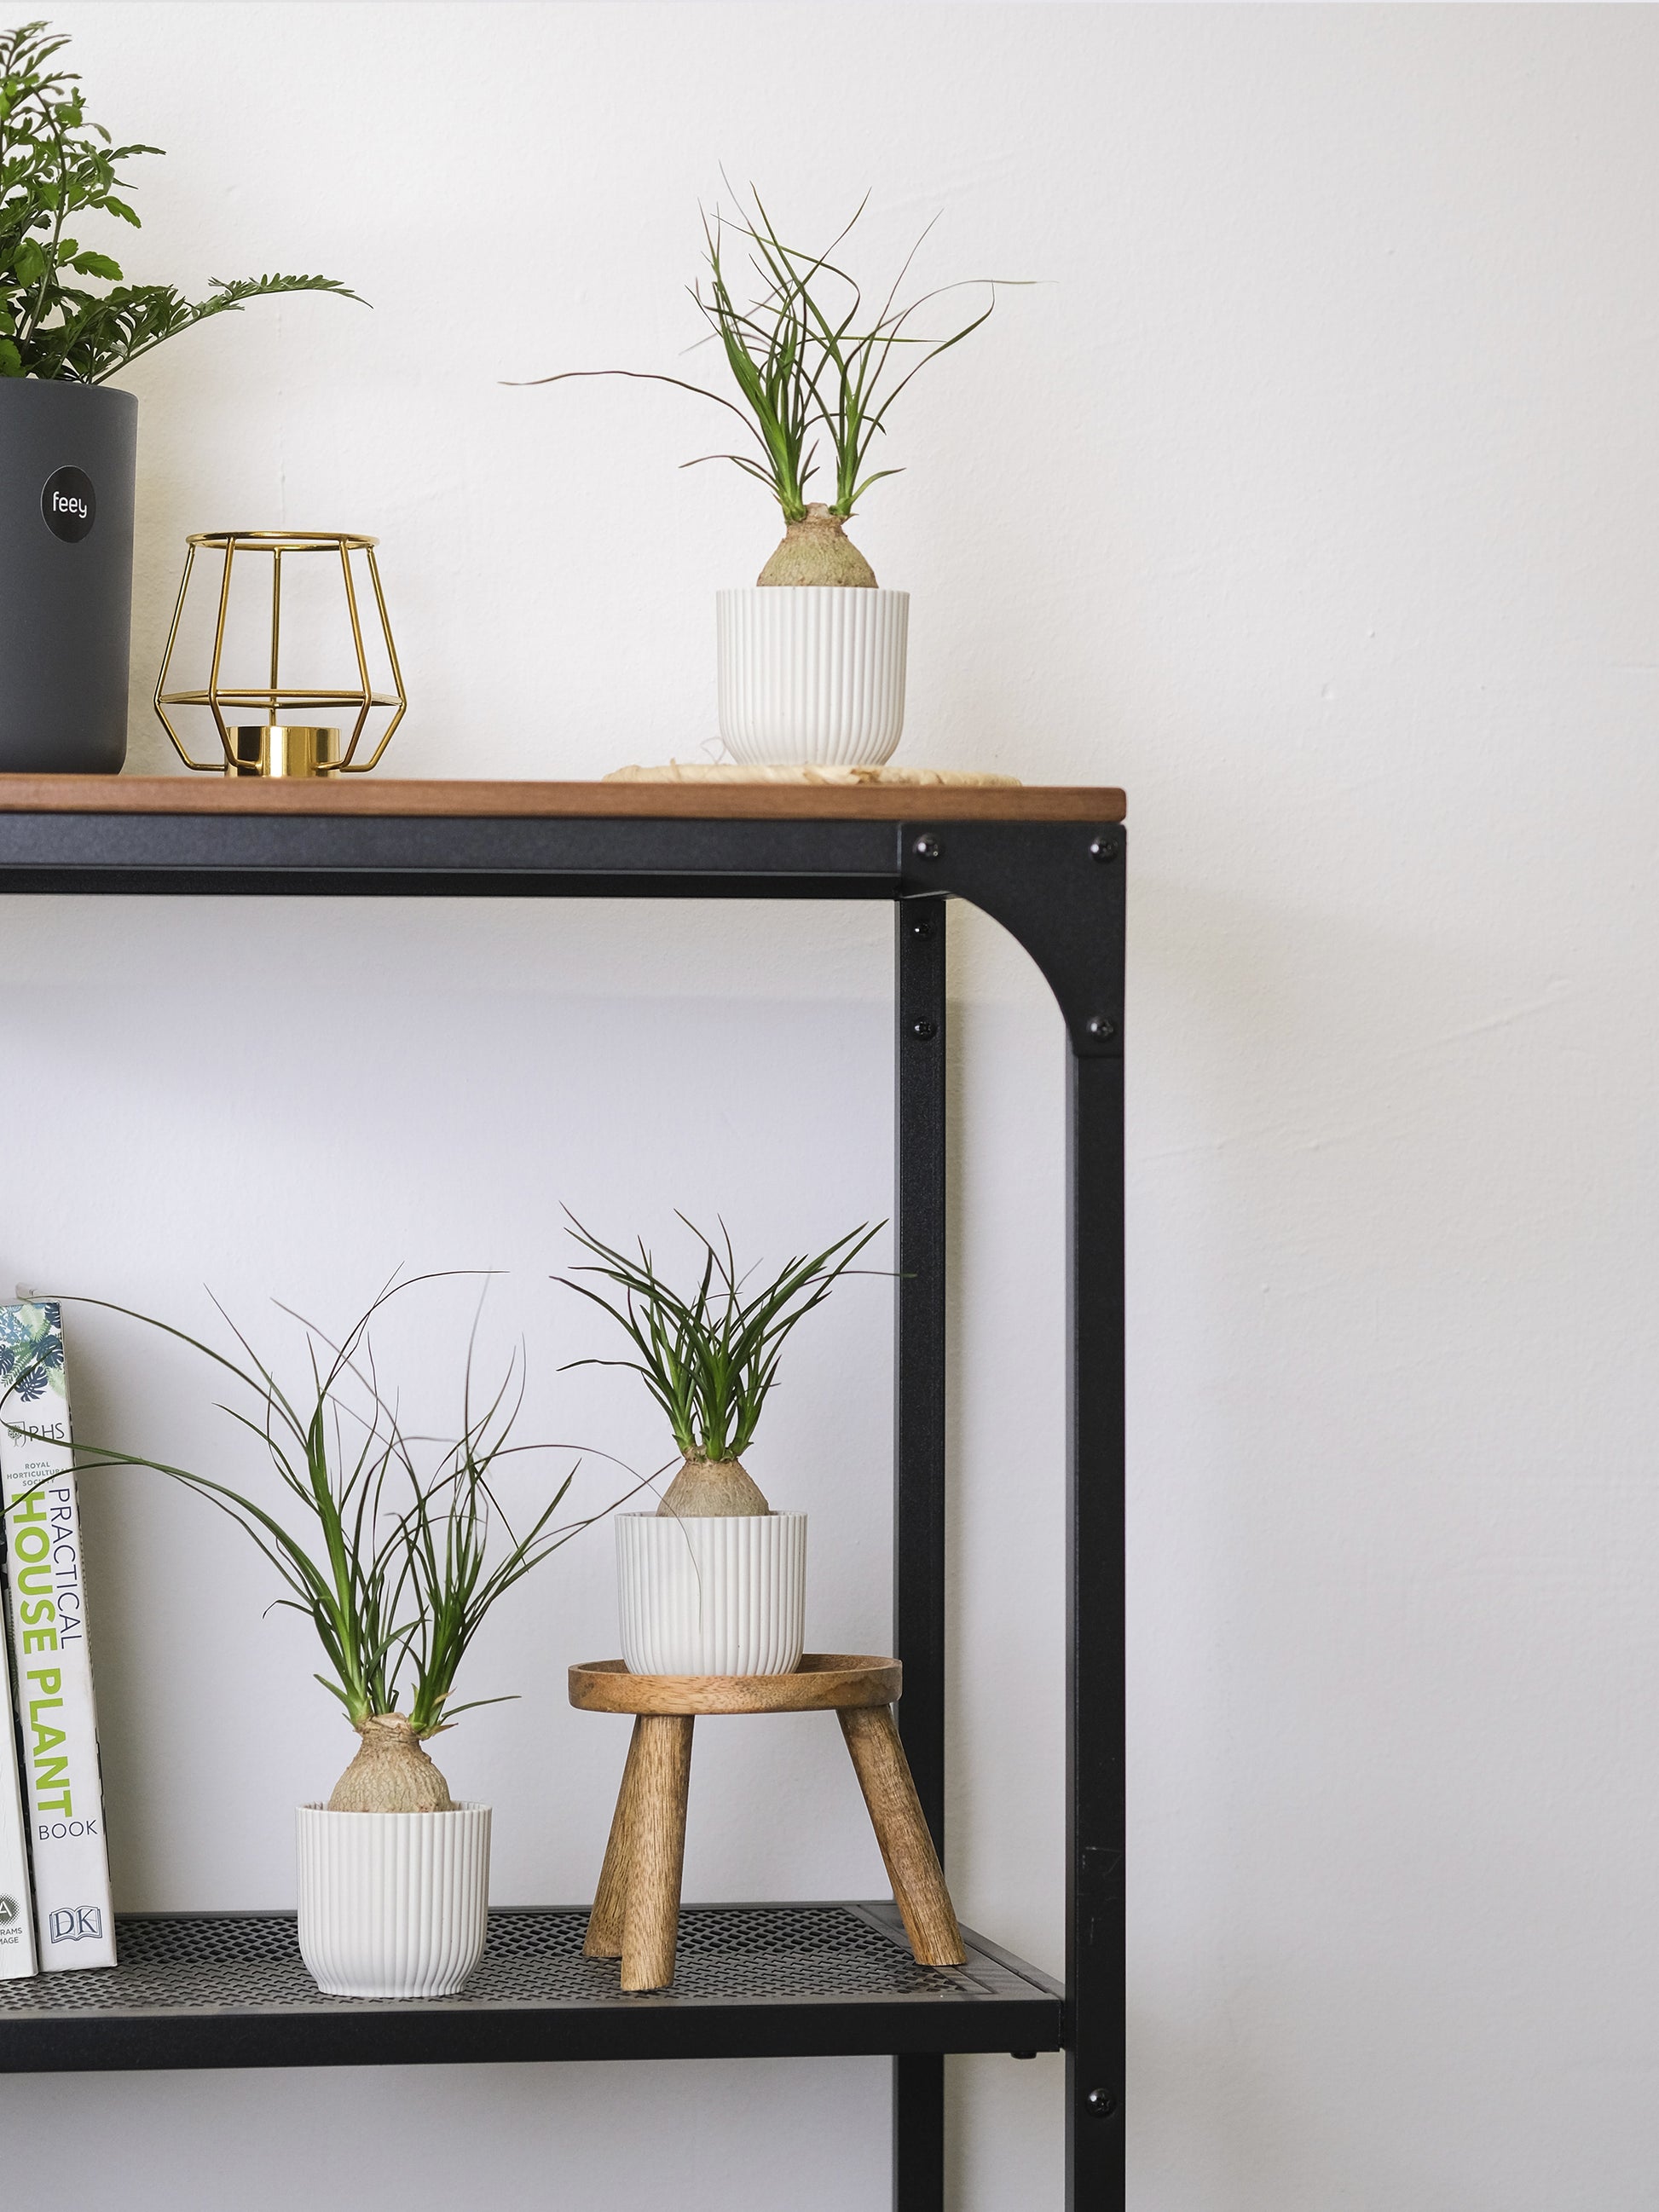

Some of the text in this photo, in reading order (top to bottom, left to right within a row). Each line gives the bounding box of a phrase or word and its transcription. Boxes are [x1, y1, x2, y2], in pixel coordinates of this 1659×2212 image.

[53, 491, 88, 519] feey
[29, 1423, 65, 1441] RHS
[6, 1468, 69, 1480] HORTICULTUR
[25, 1461, 50, 1470] ROYAL
[22, 1477, 55, 1487] SOCY
[49, 1488, 82, 1650] PRACTICAL
[11, 1491, 72, 1817] HOUSE PLANT
[38, 1820, 98, 1840] BOOK
[54, 1908, 99, 1938] DK
